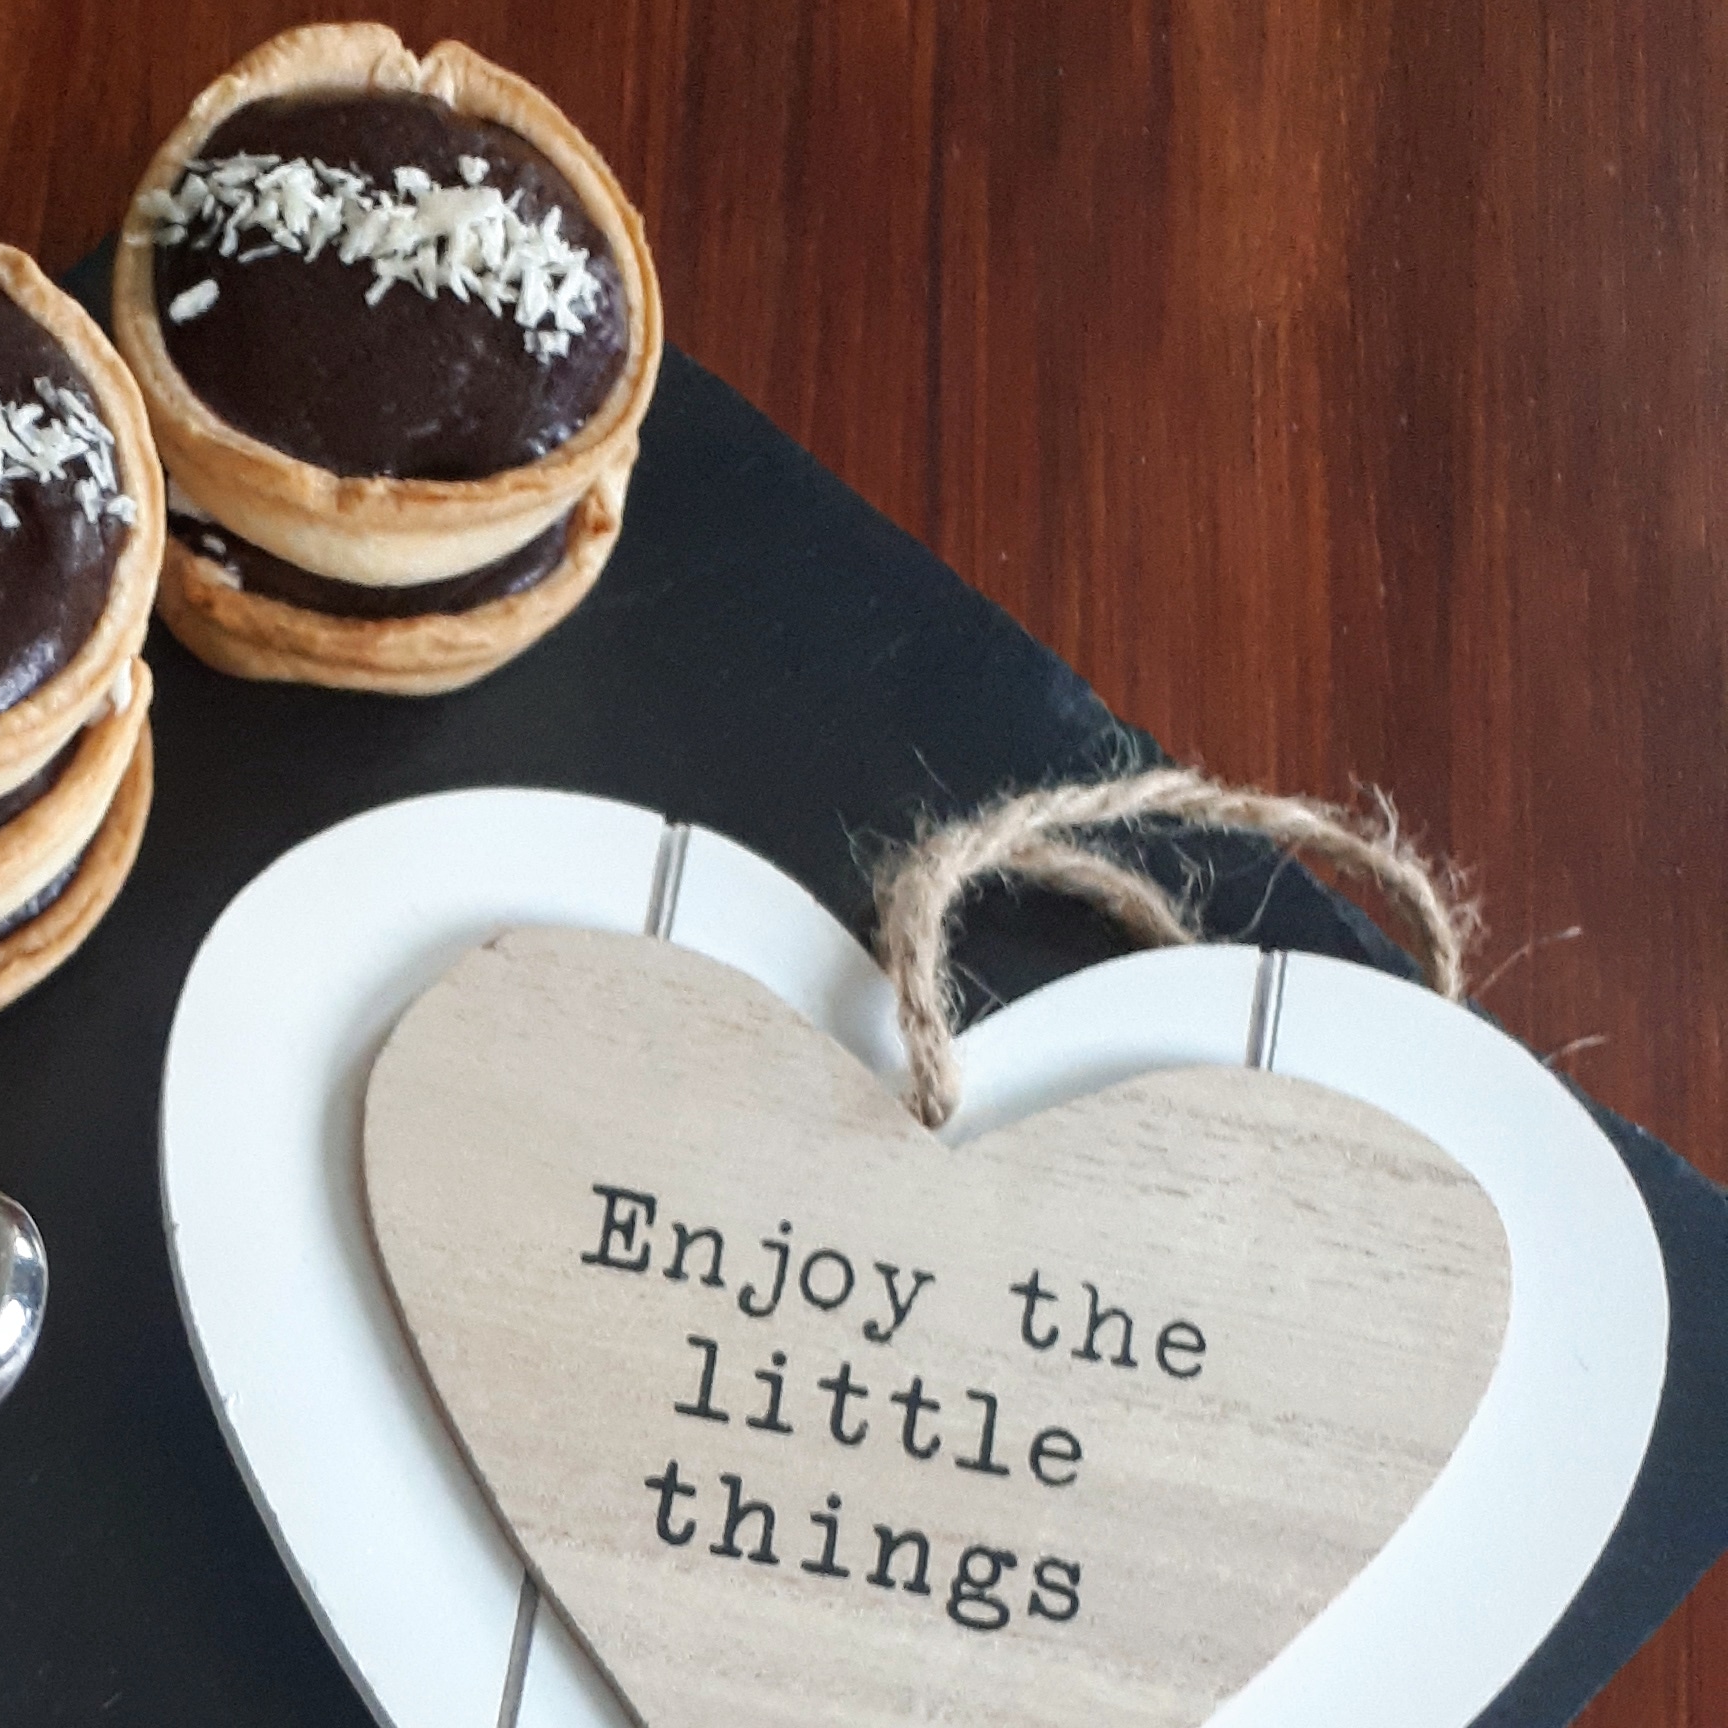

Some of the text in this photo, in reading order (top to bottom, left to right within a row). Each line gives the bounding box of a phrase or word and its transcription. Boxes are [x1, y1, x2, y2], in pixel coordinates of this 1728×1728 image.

[579, 1183, 1209, 1381] Enjoy the
[672, 1333, 1084, 1489] little
[643, 1459, 1084, 1634] things
